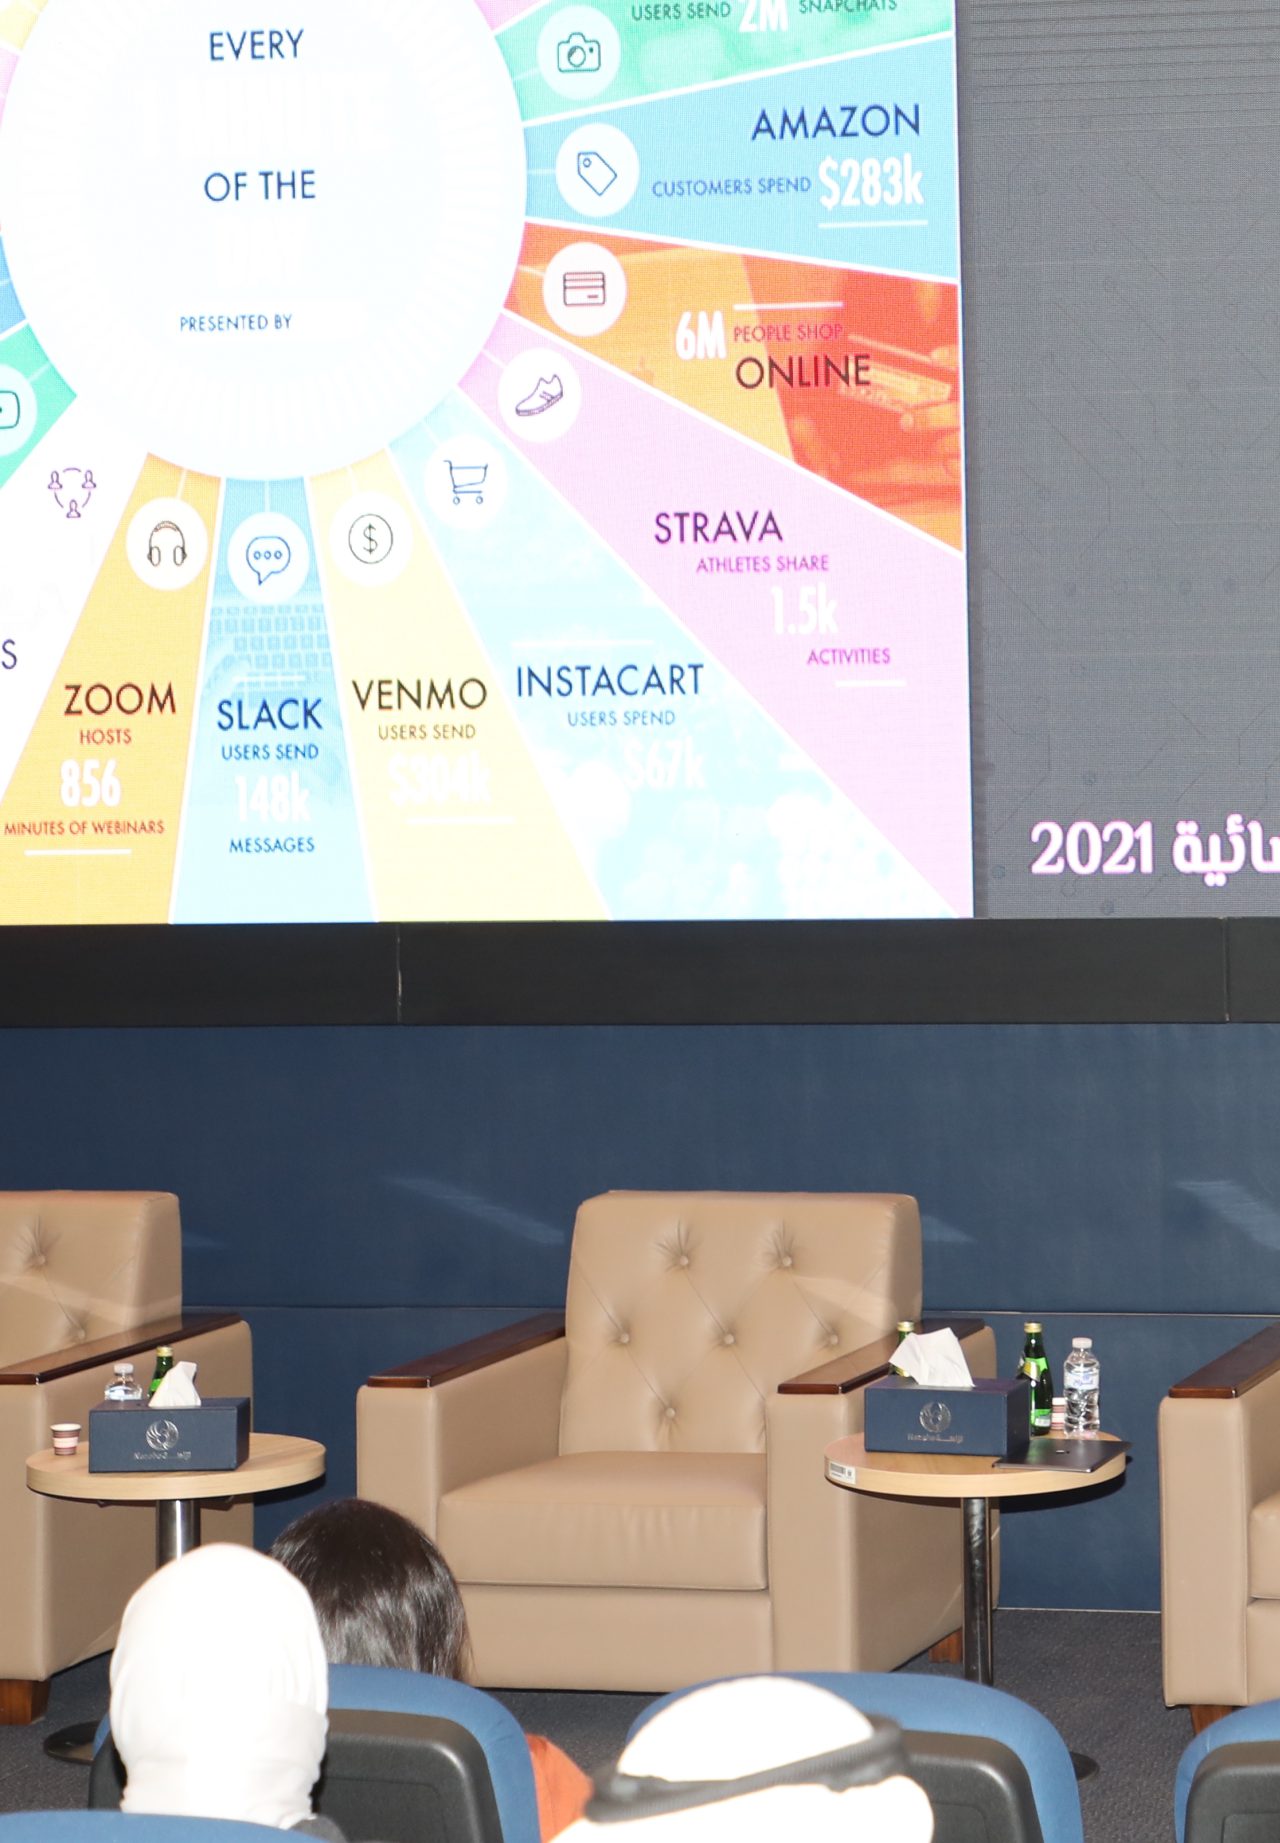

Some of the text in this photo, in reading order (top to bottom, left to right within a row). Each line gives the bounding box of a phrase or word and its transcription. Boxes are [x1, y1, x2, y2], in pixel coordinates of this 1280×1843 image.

[631, 0, 897, 33] USERS SEND 2M SNAPCHATS
[210, 29, 304, 61] EVERY
[751, 104, 921, 141] AMAZON
[204, 170, 316, 202] OF THE
[652, 152, 924, 210] CUSTOMERS SPEND $283k
[180, 314, 292, 332] PRESENTED BY
[675, 311, 726, 360] 6M
[734, 323, 844, 343] PEOPLE SHOP
[736, 354, 871, 390] ONLINE
[654, 511, 783, 544] STRAVA
[696, 555, 829, 573] ATHLETES SHARE
[770, 583, 838, 635] 1.5k
[807, 648, 891, 666] ACTIVITIES
[353, 677, 487, 711] VENMO
[517, 664, 704, 697] INSTACART
[64, 683, 176, 716] ZOOM
[217, 698, 322, 731] SLACK
[378, 724, 476, 741] USERS SEND
[567, 710, 675, 726] USERS SPEND
[79, 729, 131, 745] HOSTS
[221, 743, 319, 760] USERS SEND
[61, 760, 121, 807] 856
[235, 771, 311, 823] 148k
[4, 820, 165, 836] MINUTES OF WEBINARS
[229, 837, 315, 853] MESSAGES
[1031, 820, 1154, 874] 2021
